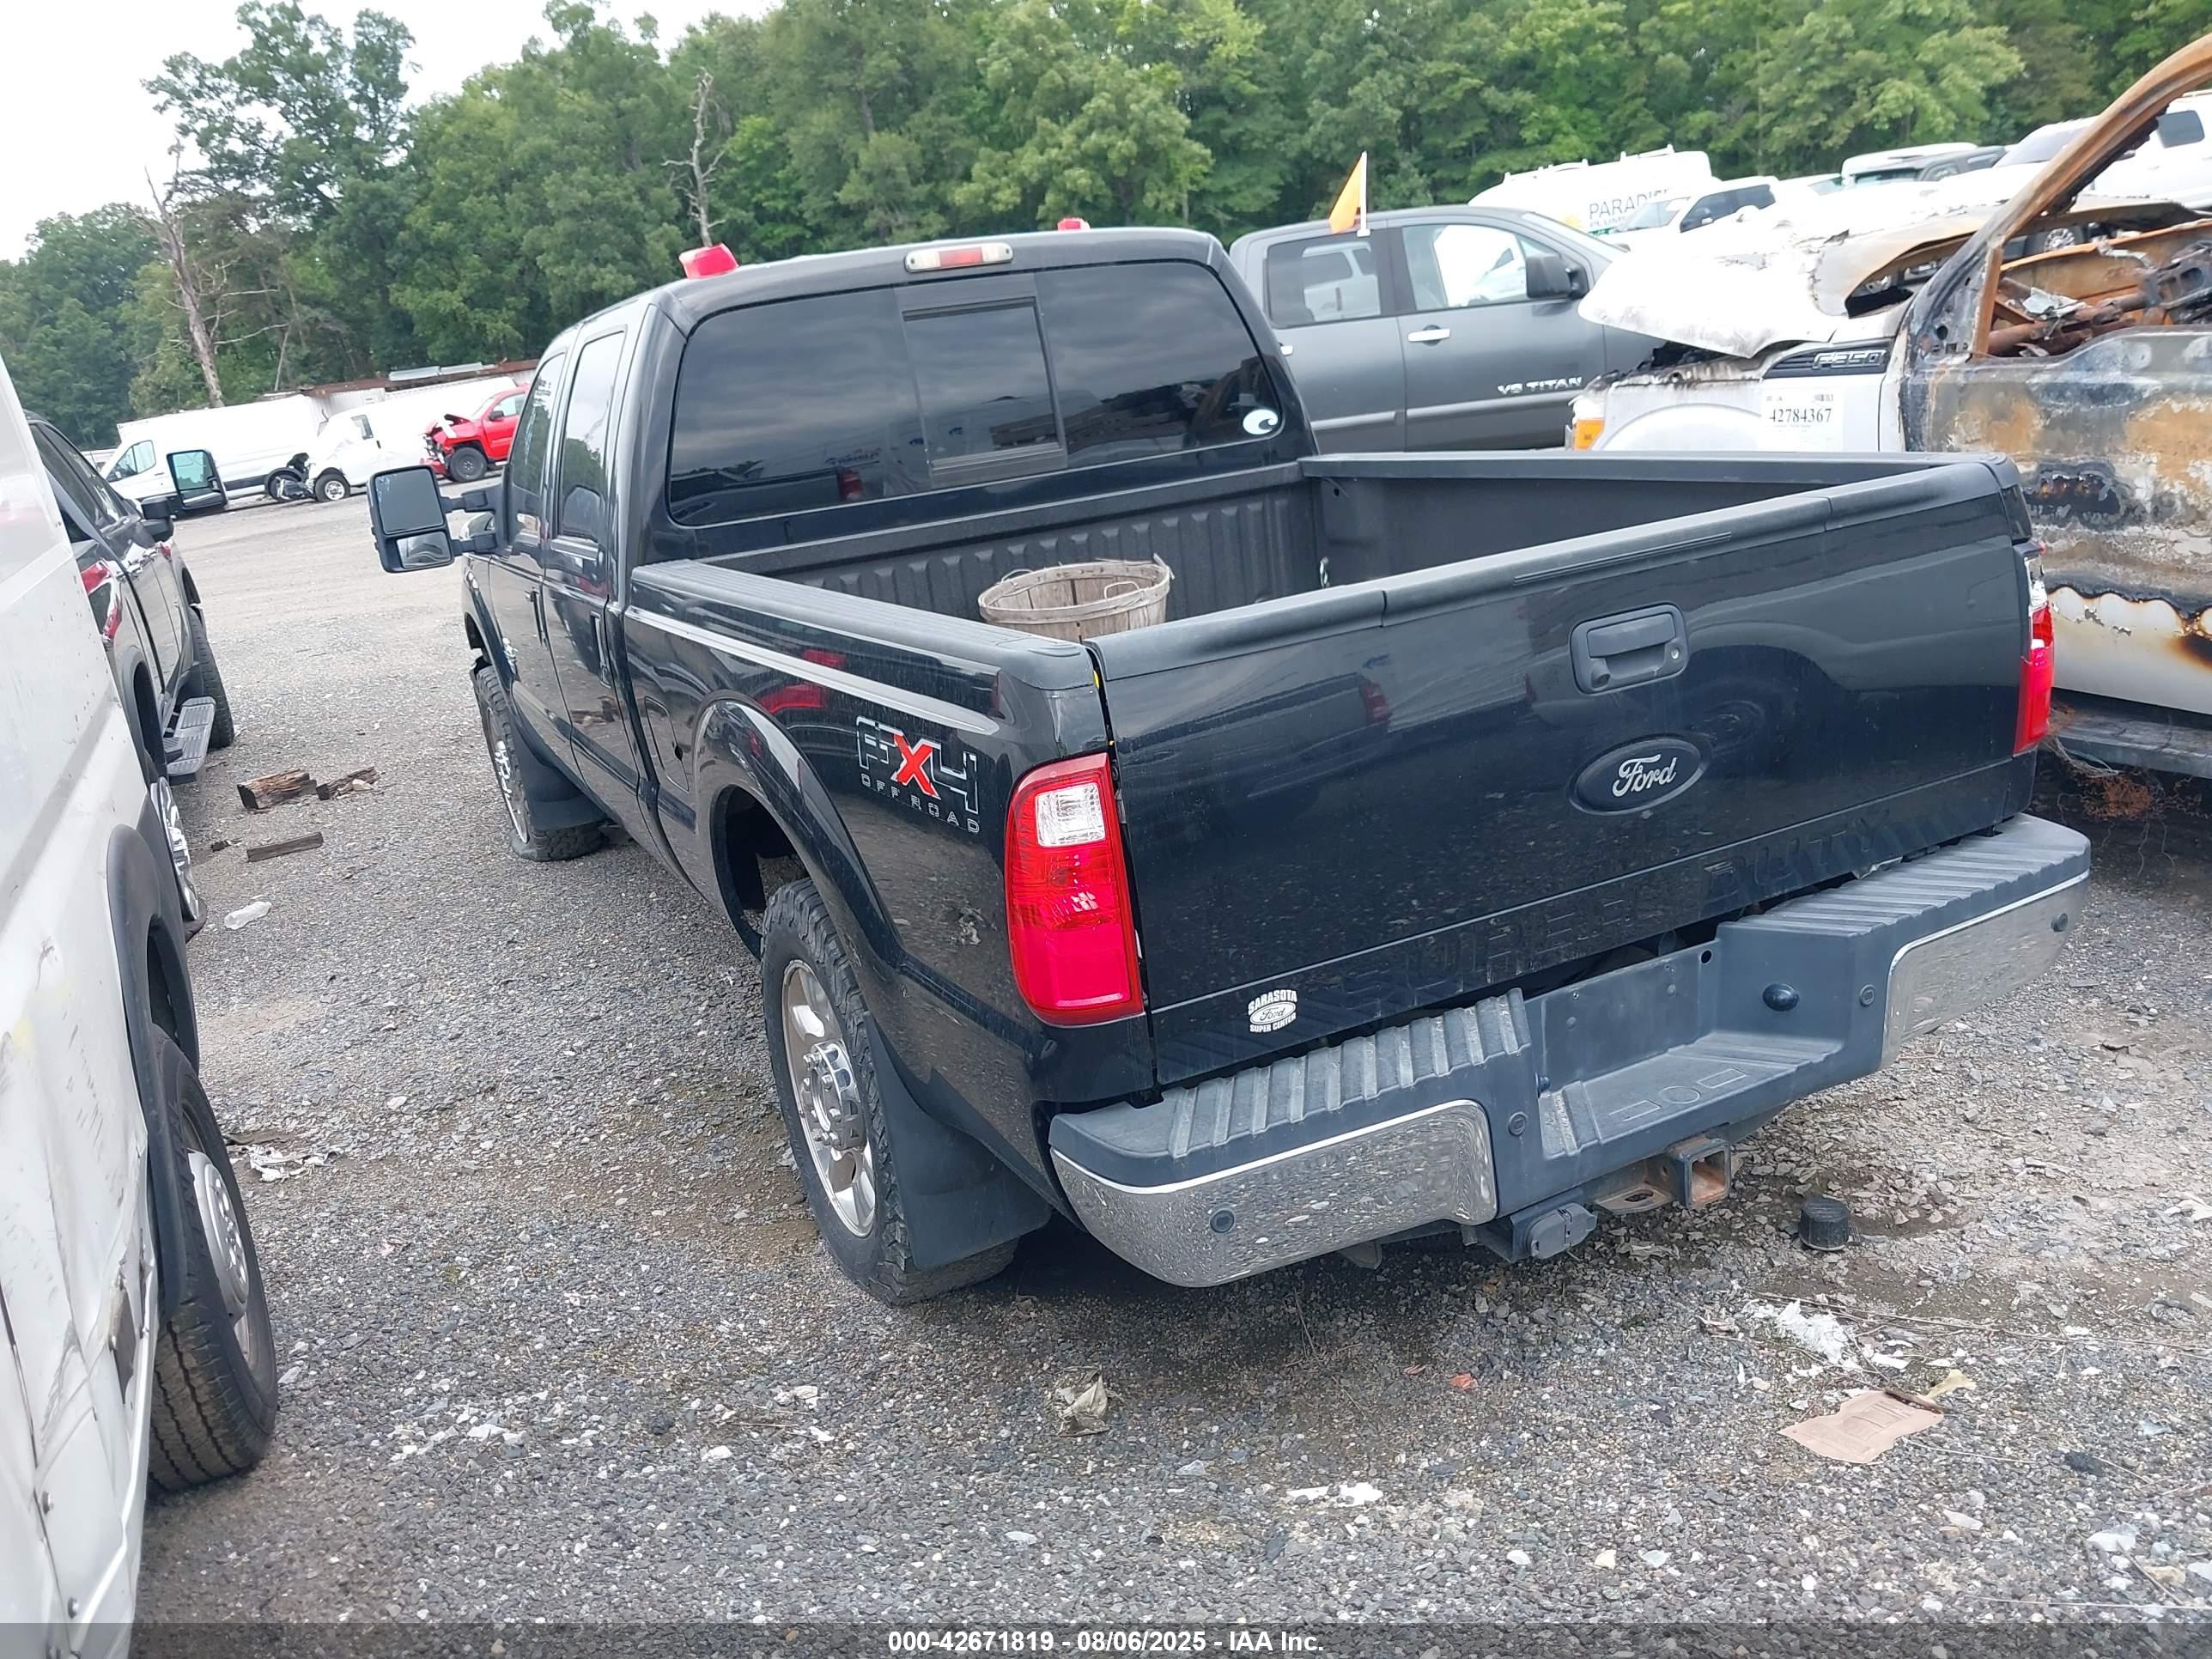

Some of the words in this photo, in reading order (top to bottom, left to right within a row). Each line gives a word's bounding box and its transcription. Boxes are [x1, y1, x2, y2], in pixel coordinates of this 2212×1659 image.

[1526, 376, 1583, 392] TITAN
[1769, 407, 1832, 423] 42784367
[856, 716, 979, 815] FX4
[1612, 753, 1677, 797] Ford
[1248, 989, 1297, 1016] SARASOTA
[1260, 1007, 1286, 1021] Ford
[1249, 1024, 1272, 1033] SUPER
